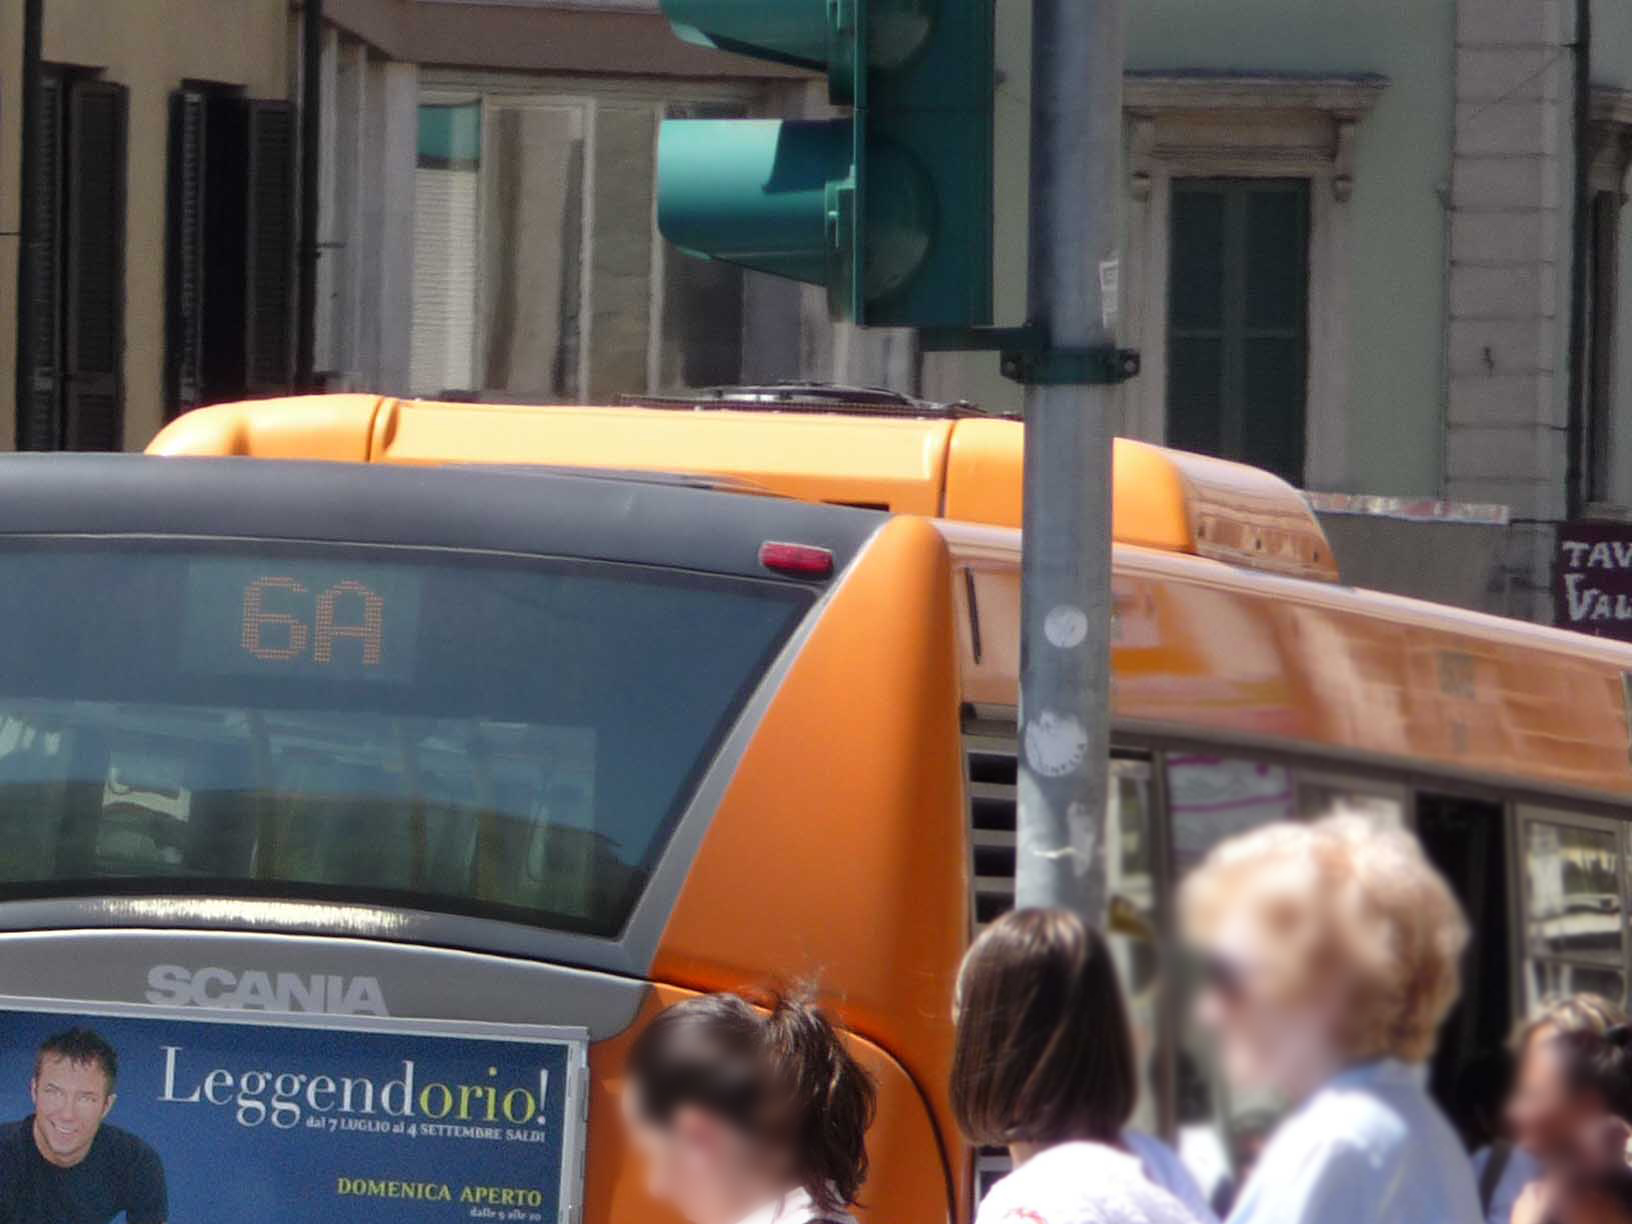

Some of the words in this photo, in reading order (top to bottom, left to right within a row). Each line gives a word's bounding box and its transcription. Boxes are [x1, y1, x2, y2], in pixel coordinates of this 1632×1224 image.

[241, 576, 384, 665] 6A
[144, 964, 390, 1017] SCANIA
[158, 1045, 550, 1129] Leggendorio!
[306, 1116, 327, 1129] dal
[329, 1119, 338, 1132] 7
[340, 1118, 391, 1133] LUGLIO
[392, 1123, 405, 1133] al
[406, 1122, 418, 1139] 4
[420, 1123, 502, 1140] SETTEMBRE
[506, 1129, 546, 1143] SALDI
[337, 1177, 452, 1201] DOMENICA
[459, 1187, 543, 1207] APERTO
